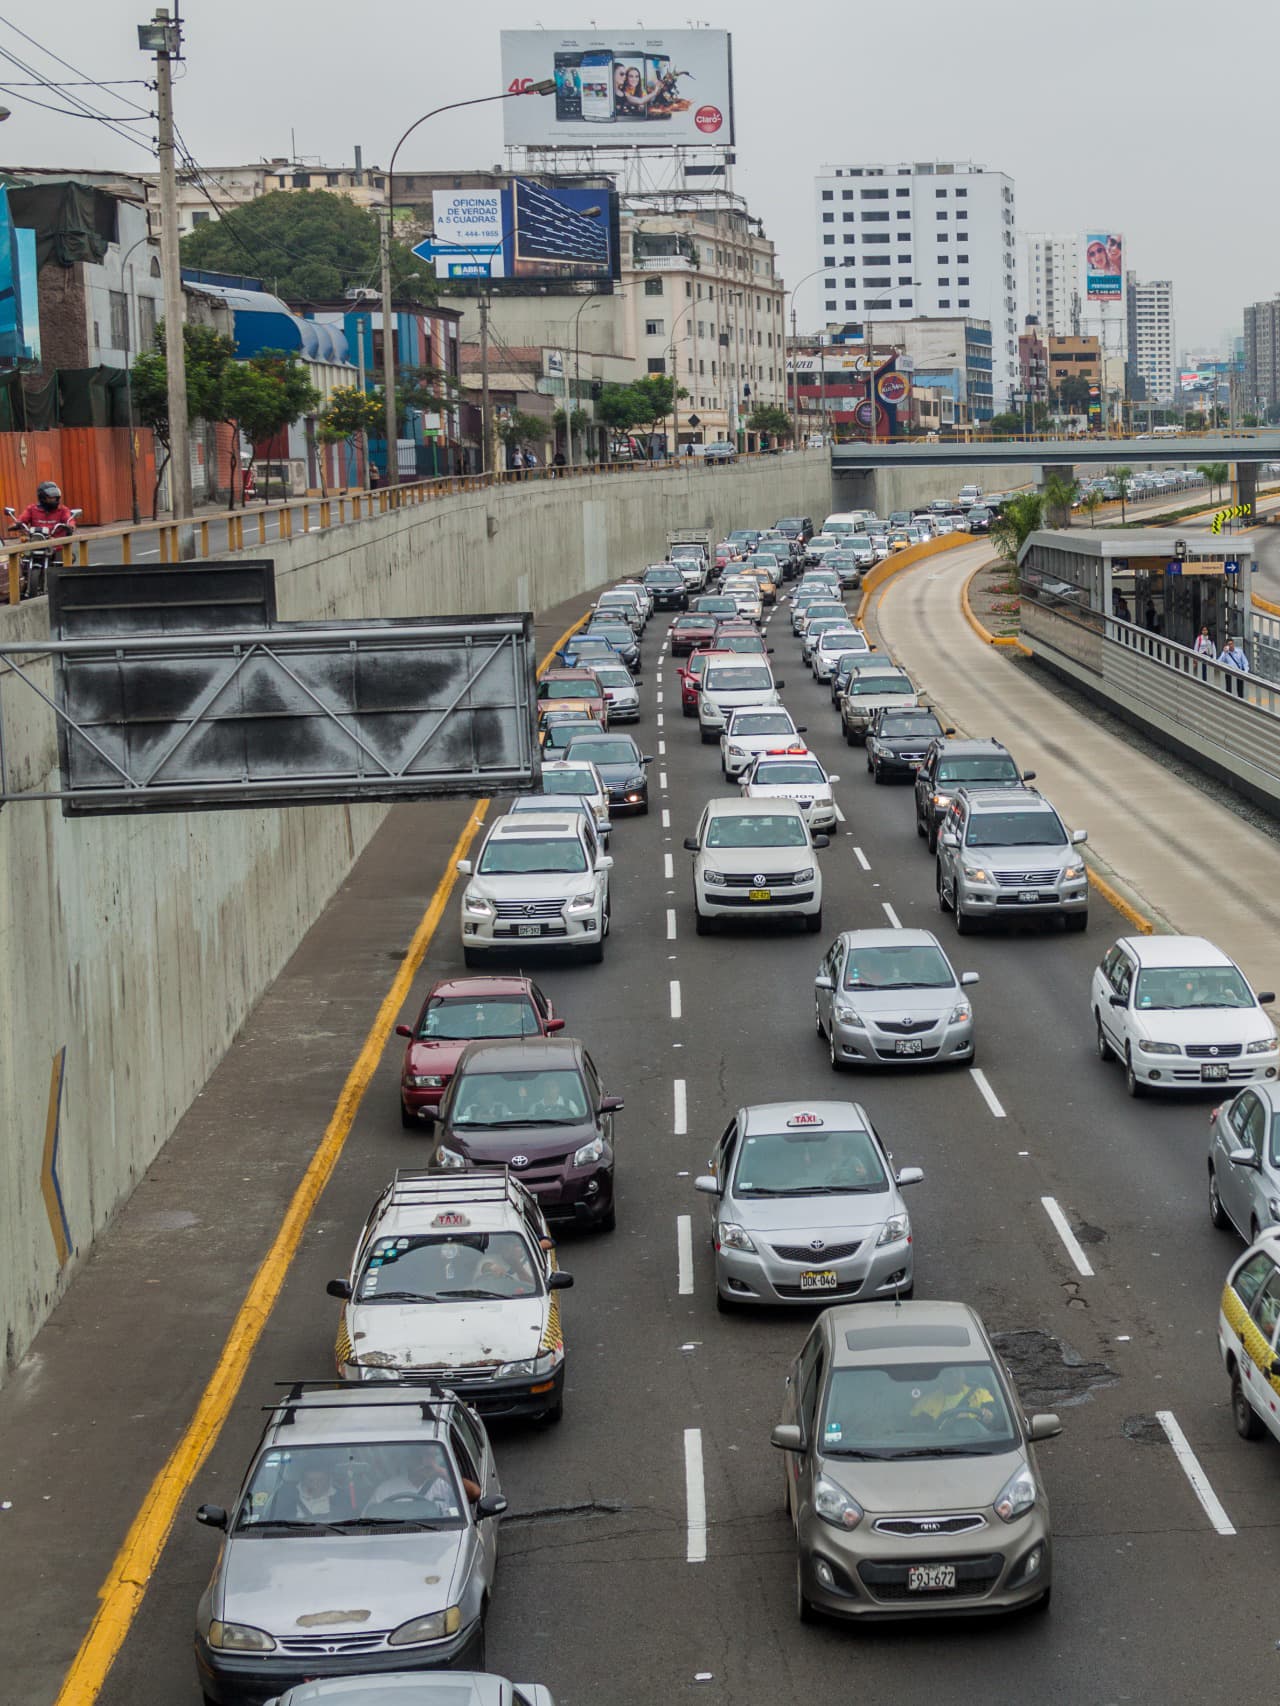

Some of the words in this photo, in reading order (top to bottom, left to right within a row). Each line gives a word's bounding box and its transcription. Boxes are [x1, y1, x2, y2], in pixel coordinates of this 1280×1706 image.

[696, 114, 718, 124] Claro
[453, 199, 497, 207] OFICINAS
[447, 208, 460, 216] DE
[462, 207, 498, 216] VERDAD
[452, 216, 498, 224] CUADRAS.
[462, 266, 487, 274] ABRIL
[795, 1115, 815, 1123] TAXI
[439, 1215, 463, 1225] TAXI
[910, 1571, 954, 1587] F9J-677
